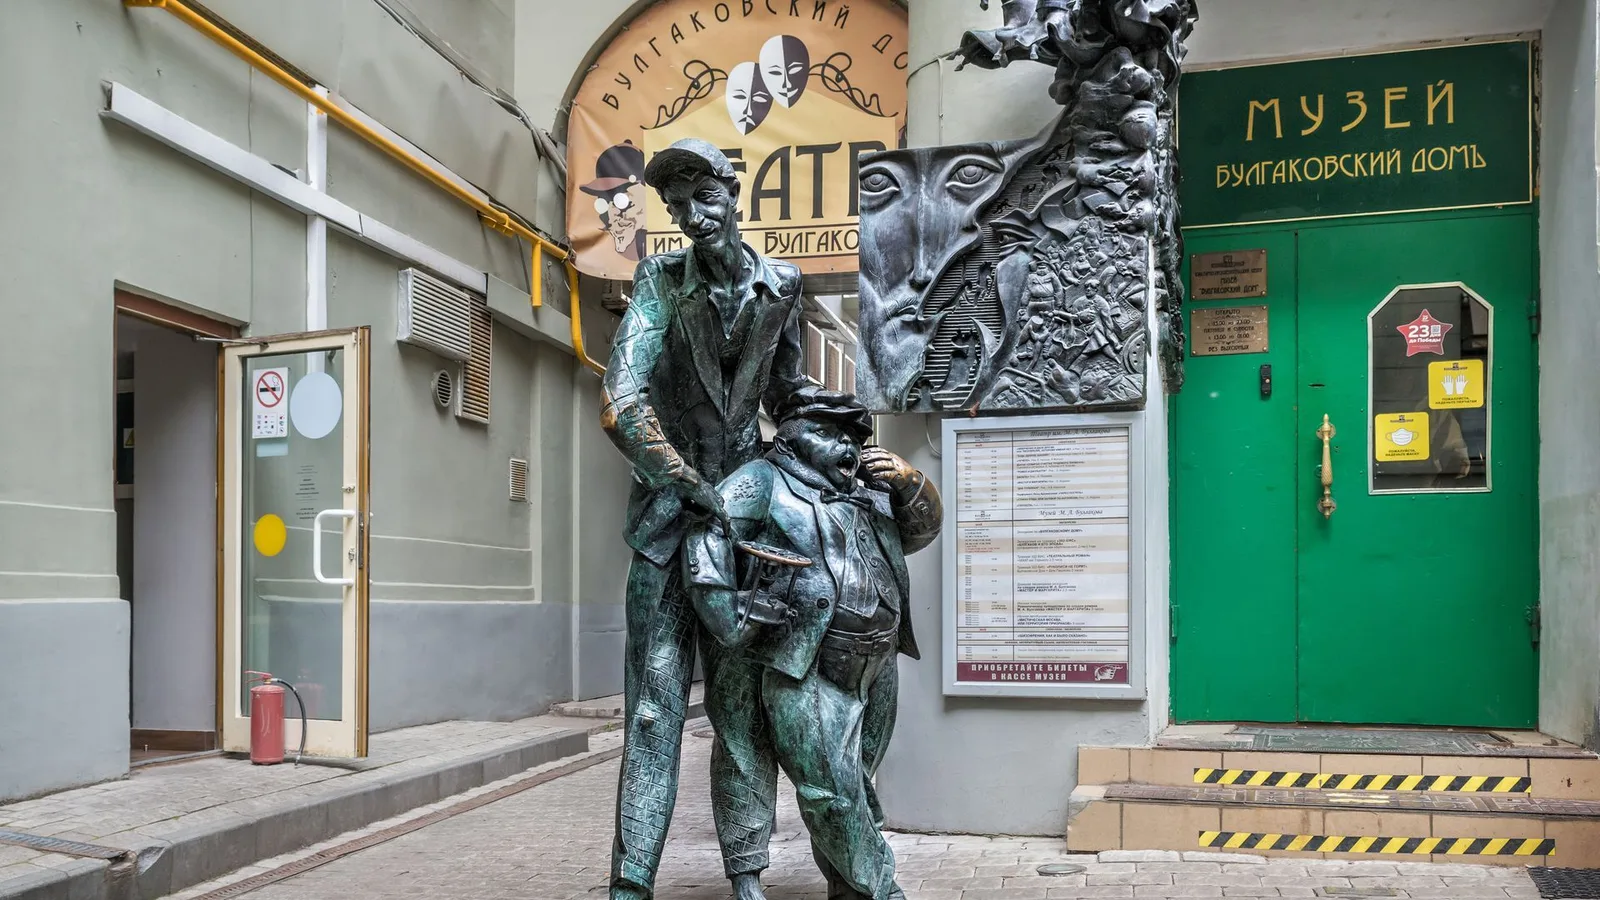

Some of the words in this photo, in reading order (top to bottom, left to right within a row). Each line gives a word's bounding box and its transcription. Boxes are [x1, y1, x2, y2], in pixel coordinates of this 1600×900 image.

[602, 0, 850, 110] БУЛГАКОВСКИЙ
[1246, 80, 1454, 141] МУЗЕЙ
[653, 140, 888, 225] АТР
[1216, 148, 1401, 188] БУЛГАКОВСКИЙ
[1411, 144, 1487, 173] ДОМЪ
[1408, 325, 1430, 338] 23
[971, 662, 1044, 672] ПРИОБРЕТАЙТЕ
[1047, 663, 1087, 672] БИЛЕТЫ
[991, 673, 997, 681] В
[1001, 672, 1032, 681] КАССЕ
[1035, 672, 1067, 681] МУЗЕЯ
